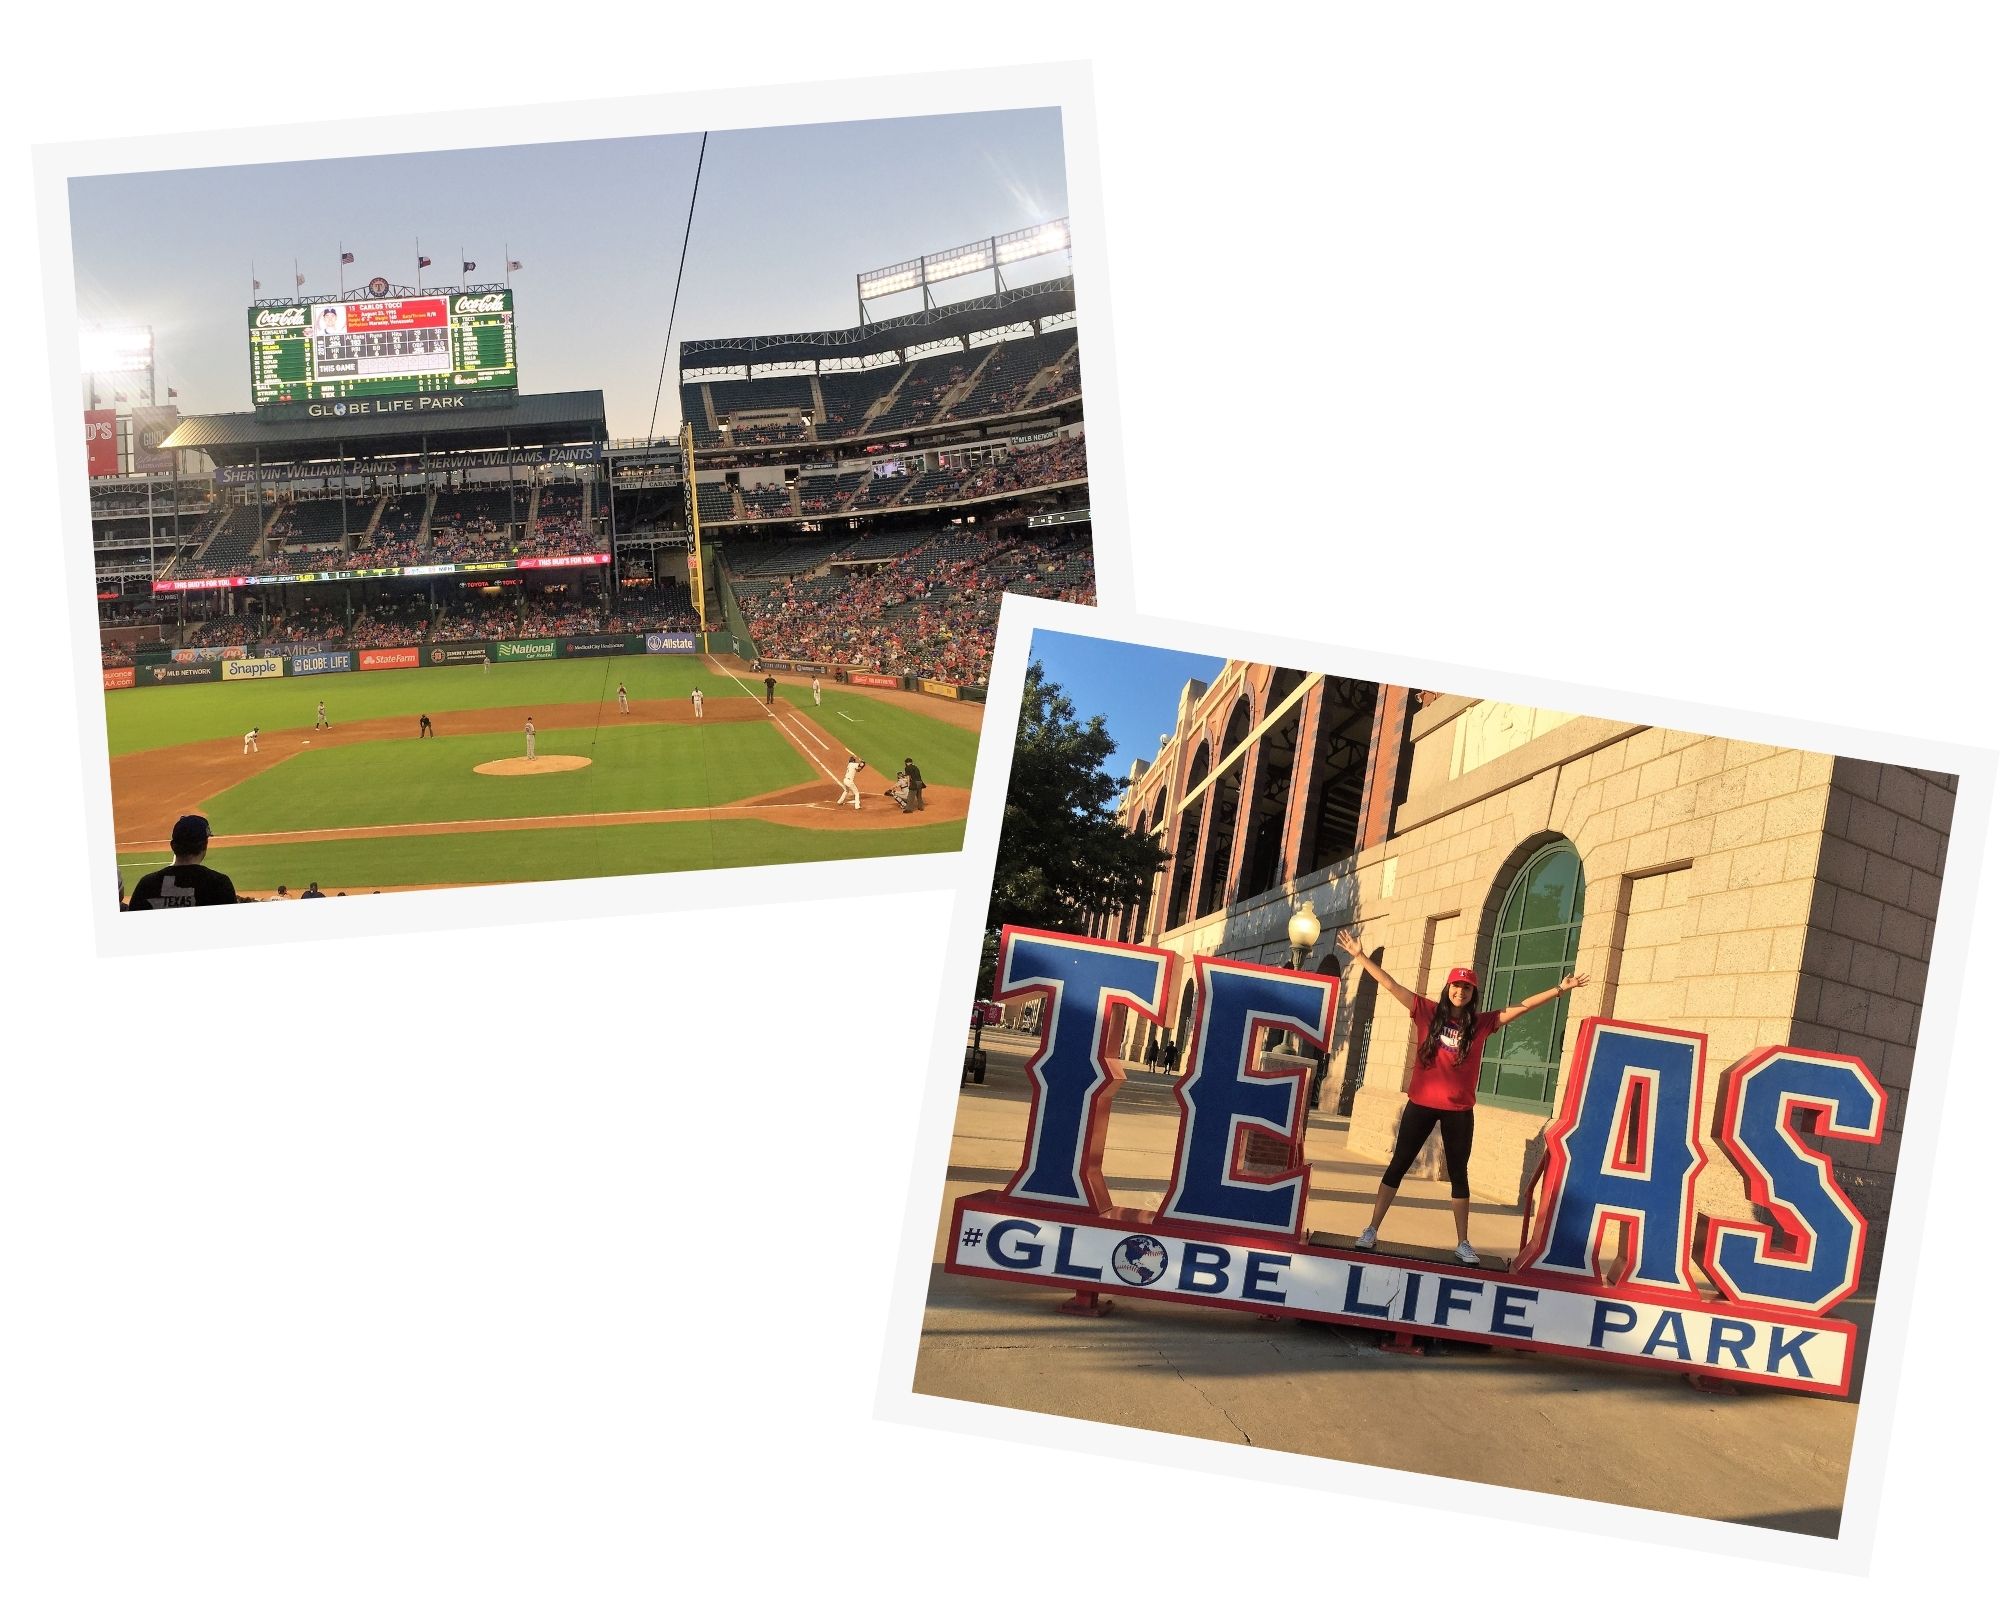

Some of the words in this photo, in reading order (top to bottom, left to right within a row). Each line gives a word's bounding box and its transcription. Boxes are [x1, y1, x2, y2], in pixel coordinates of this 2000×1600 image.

[360, 303, 384, 311] CARLOS
[385, 301, 403, 309] TOCCI
[455, 293, 506, 313] Coca-Cola
[256, 307, 307, 327] Coca-Cola
[319, 364, 336, 373] THIS
[336, 363, 356, 372] GAME
[376, 400, 414, 413] LIFE
[419, 396, 465, 410] PARK
[1019, 435, 1032, 443] MLB
[1033, 430, 1055, 441] NETWORK
[548, 447, 593, 462] PAINTS
[353, 461, 397, 475] PAINTS
[621, 481, 637, 490] RITA
[649, 480, 678, 488] CABANA
[174, 581, 187, 590] THIS
[206, 580, 217, 588] FOR
[285, 643, 322, 656] Mitel
[511, 643, 554, 655] National
[662, 637, 693, 649] Allstate
[229, 661, 276, 676] Snapple
[303, 657, 328, 670] GLOBE
[330, 656, 348, 669] LIFE
[181, 668, 211, 676] NETWORK
[1341, 1264, 1541, 1341] LIFE
[1587, 1299, 1822, 1379] PARK
